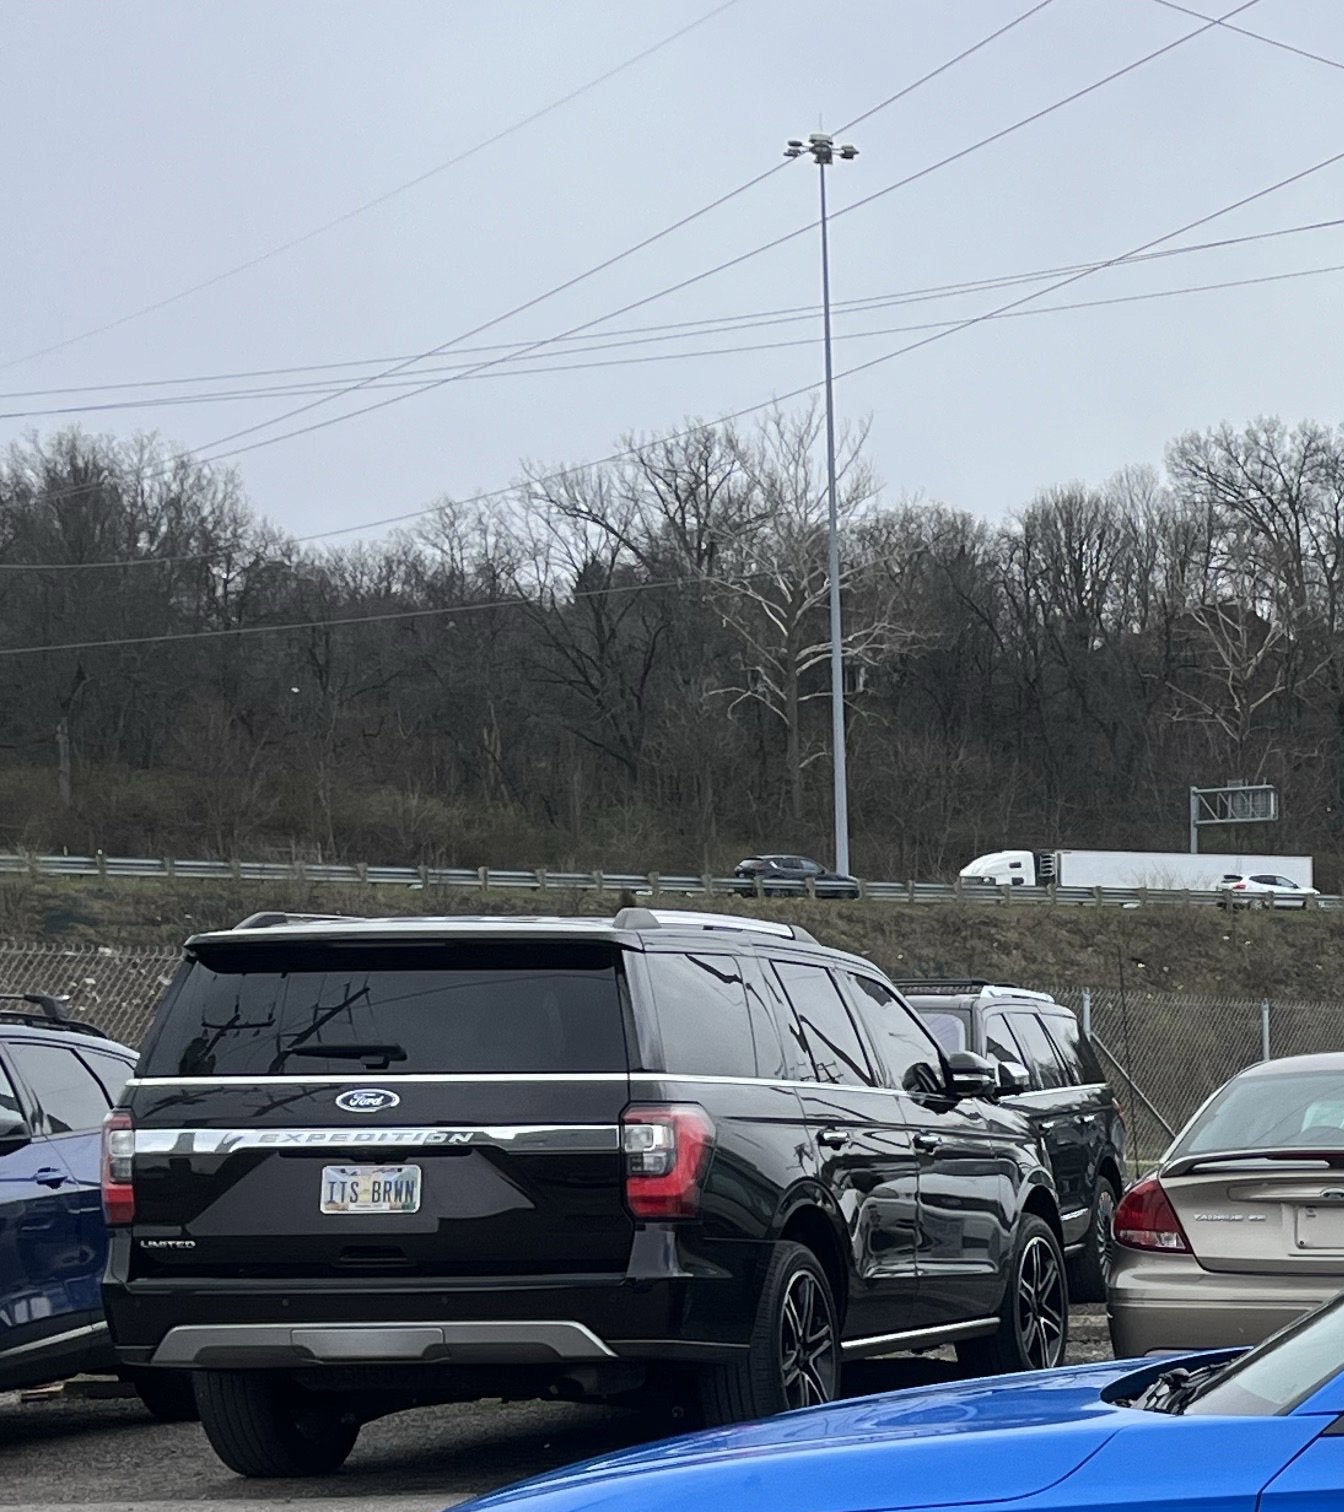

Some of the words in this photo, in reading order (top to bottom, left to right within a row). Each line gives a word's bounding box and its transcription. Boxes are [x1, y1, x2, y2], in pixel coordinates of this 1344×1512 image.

[349, 1093, 384, 1107] Ford
[258, 1132, 474, 1143] EXPEDITION
[328, 1181, 359, 1203] ITS
[372, 1181, 415, 1203] BRWN
[140, 1240, 196, 1249] LIMITED
